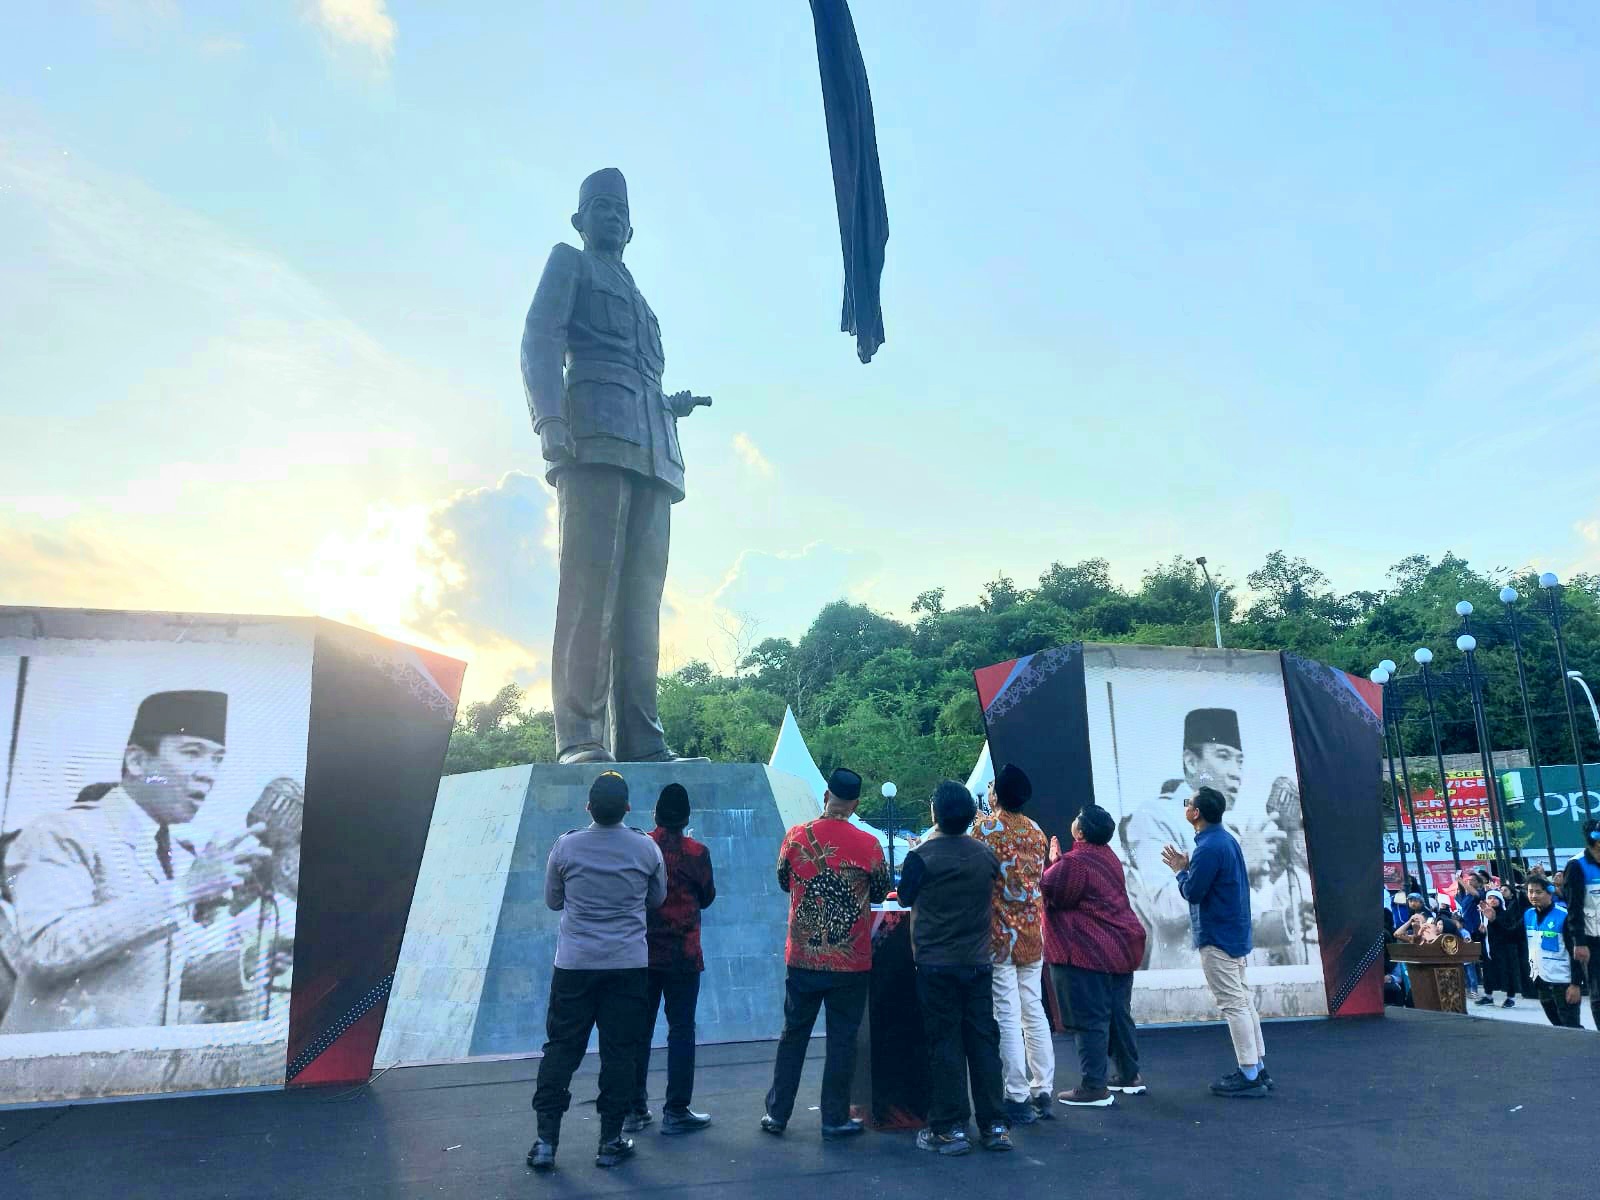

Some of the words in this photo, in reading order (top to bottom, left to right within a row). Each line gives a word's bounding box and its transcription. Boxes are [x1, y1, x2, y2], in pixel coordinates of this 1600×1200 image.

[1413, 798, 1489, 808] ERVICE
[1387, 842, 1421, 854] GADA
[1425, 841, 1441, 853] HP
[1445, 841, 1454, 852] &
[1457, 839, 1495, 852] LAPTO
